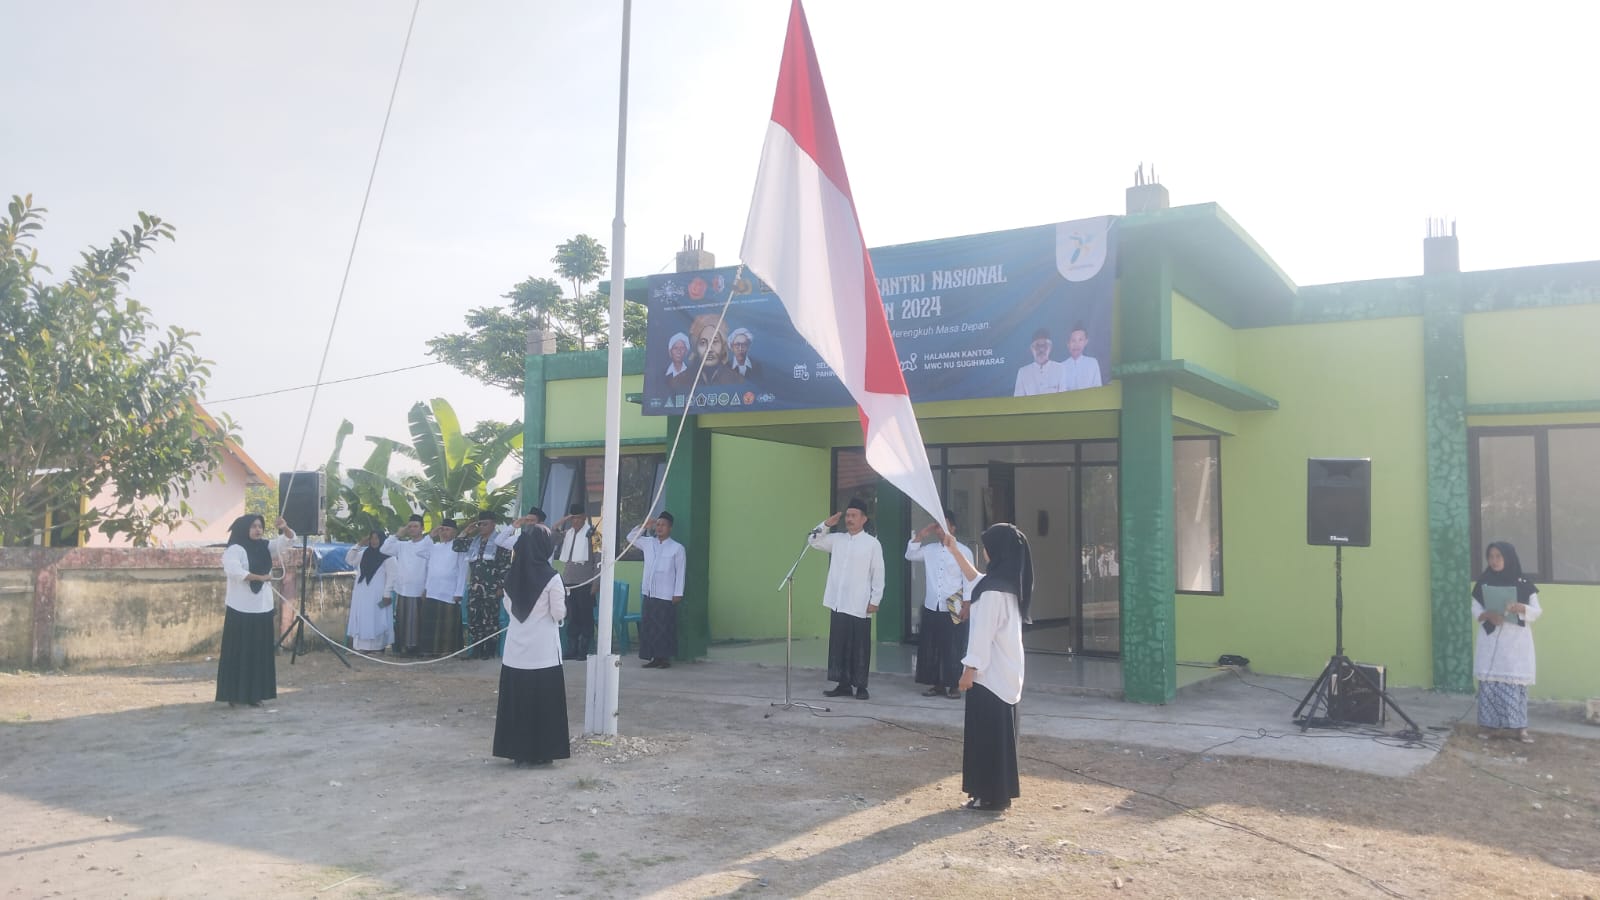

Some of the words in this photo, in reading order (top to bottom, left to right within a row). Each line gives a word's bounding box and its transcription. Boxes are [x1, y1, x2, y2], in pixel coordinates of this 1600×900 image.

[931, 263, 1008, 291] NASIONAL
[901, 296, 942, 320] 2024
[936, 324, 960, 335] Masa
[924, 351, 960, 361] HALAMAN
[961, 348, 993, 359] KANTOR
[924, 361, 942, 370] MWC
[944, 360, 955, 369] NU
[956, 357, 1005, 368] SUGIHWARAS
